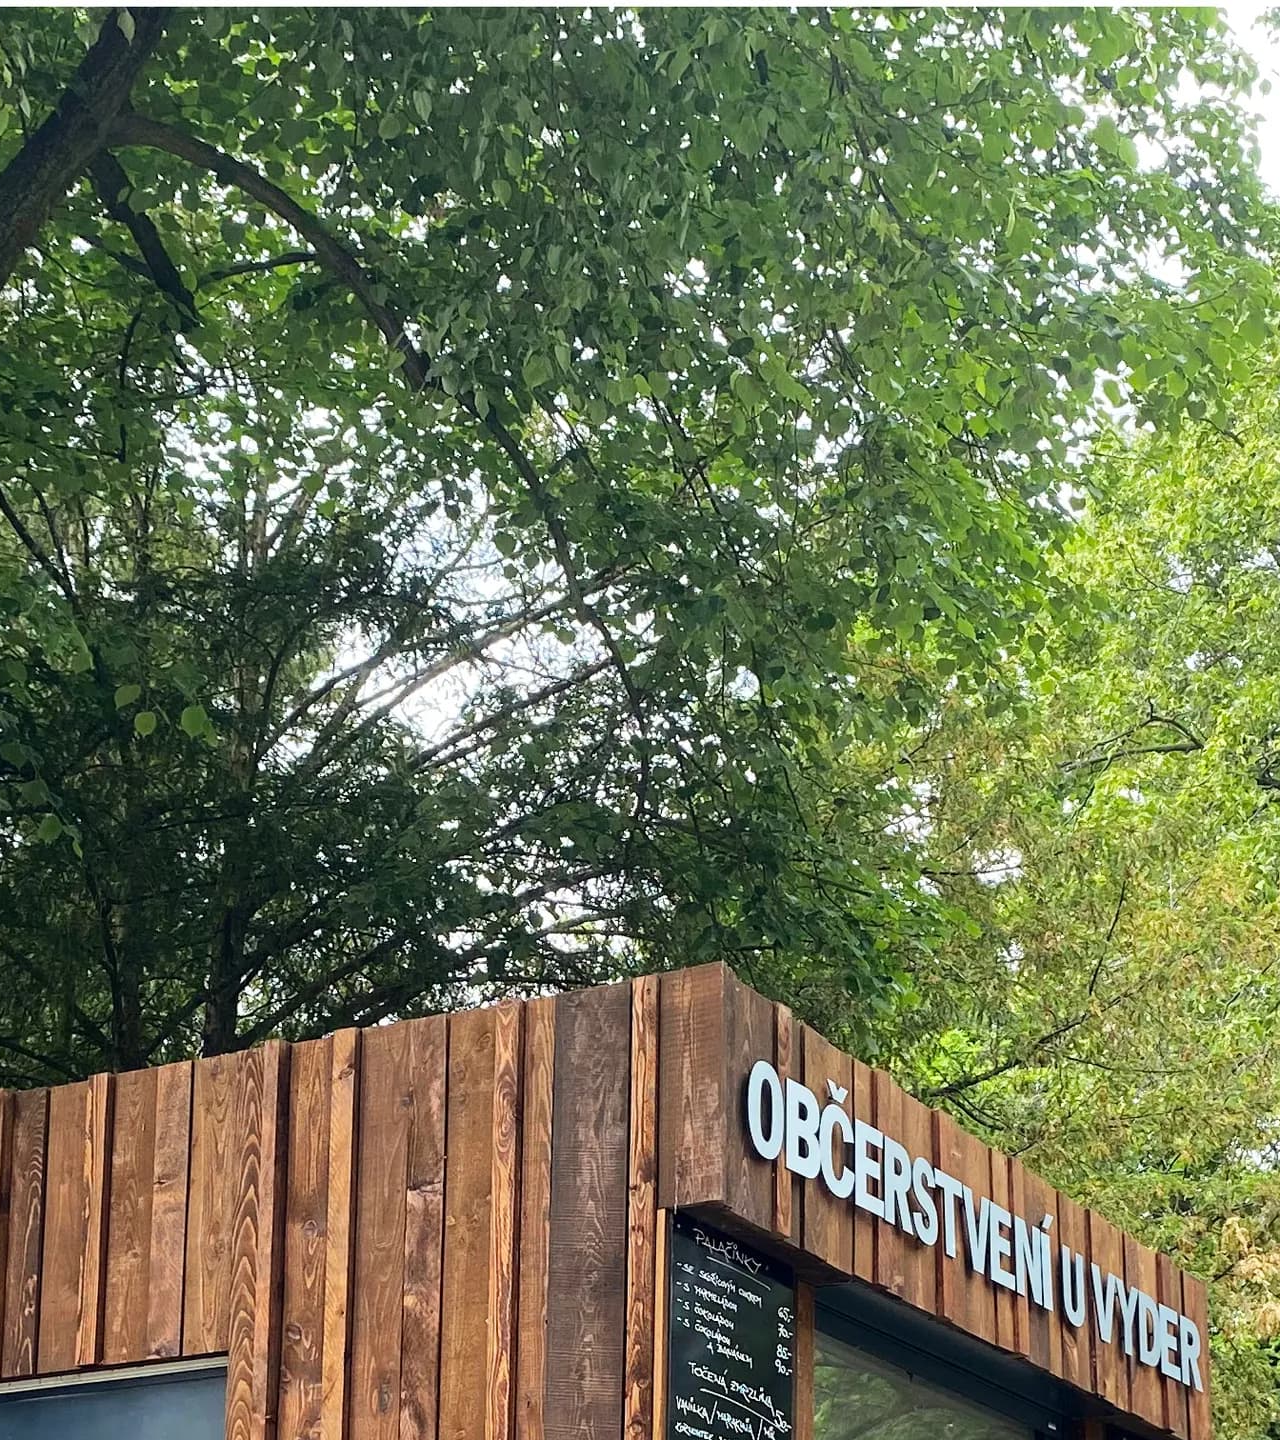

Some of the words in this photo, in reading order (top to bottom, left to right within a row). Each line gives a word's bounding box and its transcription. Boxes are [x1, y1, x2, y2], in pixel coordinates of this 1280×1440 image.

[747, 1060, 1054, 1312] OBČERSTVENÍ
[1062, 1243, 1085, 1328] U
[1091, 1262, 1204, 1393] VYDER
[688, 1362, 728, 1394] TOČENÁ
